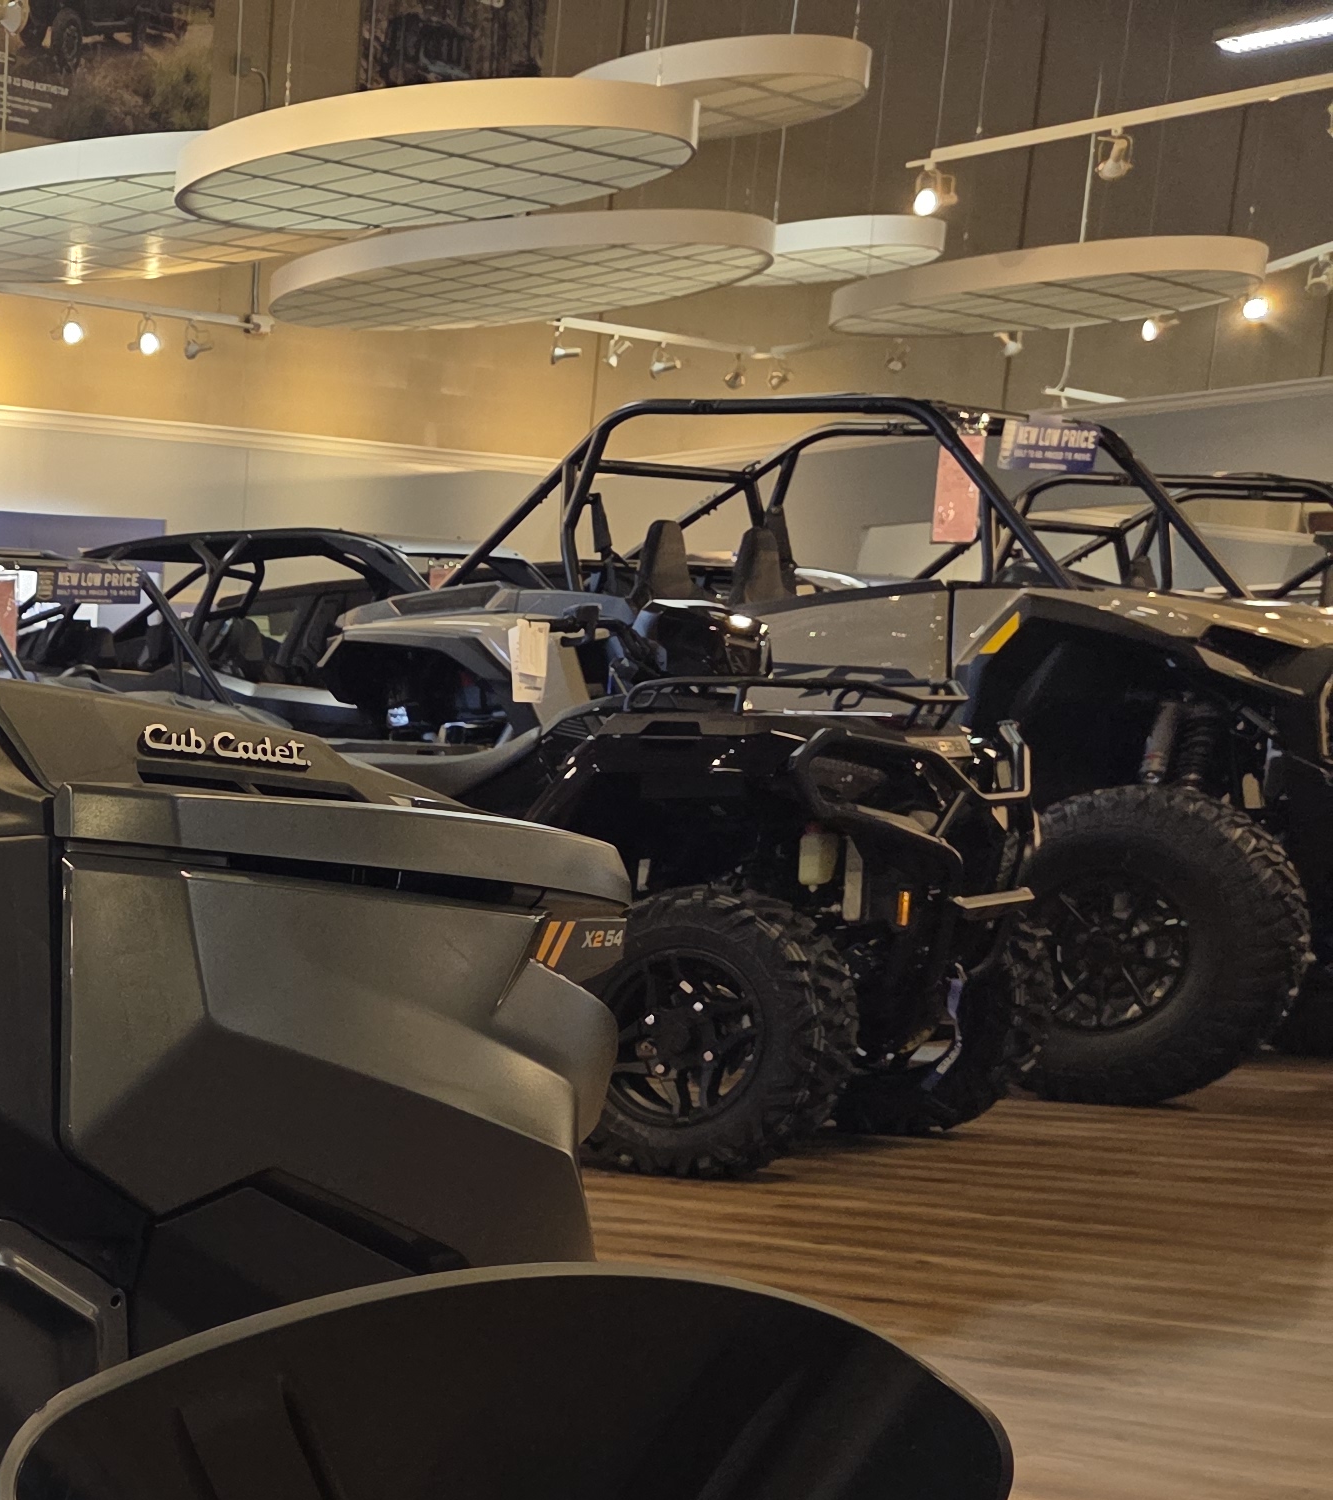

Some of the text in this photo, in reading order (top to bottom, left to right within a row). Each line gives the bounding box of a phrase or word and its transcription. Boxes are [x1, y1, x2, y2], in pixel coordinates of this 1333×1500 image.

[1061, 429, 1098, 450] PRICE
[58, 571, 80, 587] NEW
[81, 572, 102, 587] LOW
[104, 572, 140, 588] PRICE
[144, 723, 306, 766] Cub Cadet
